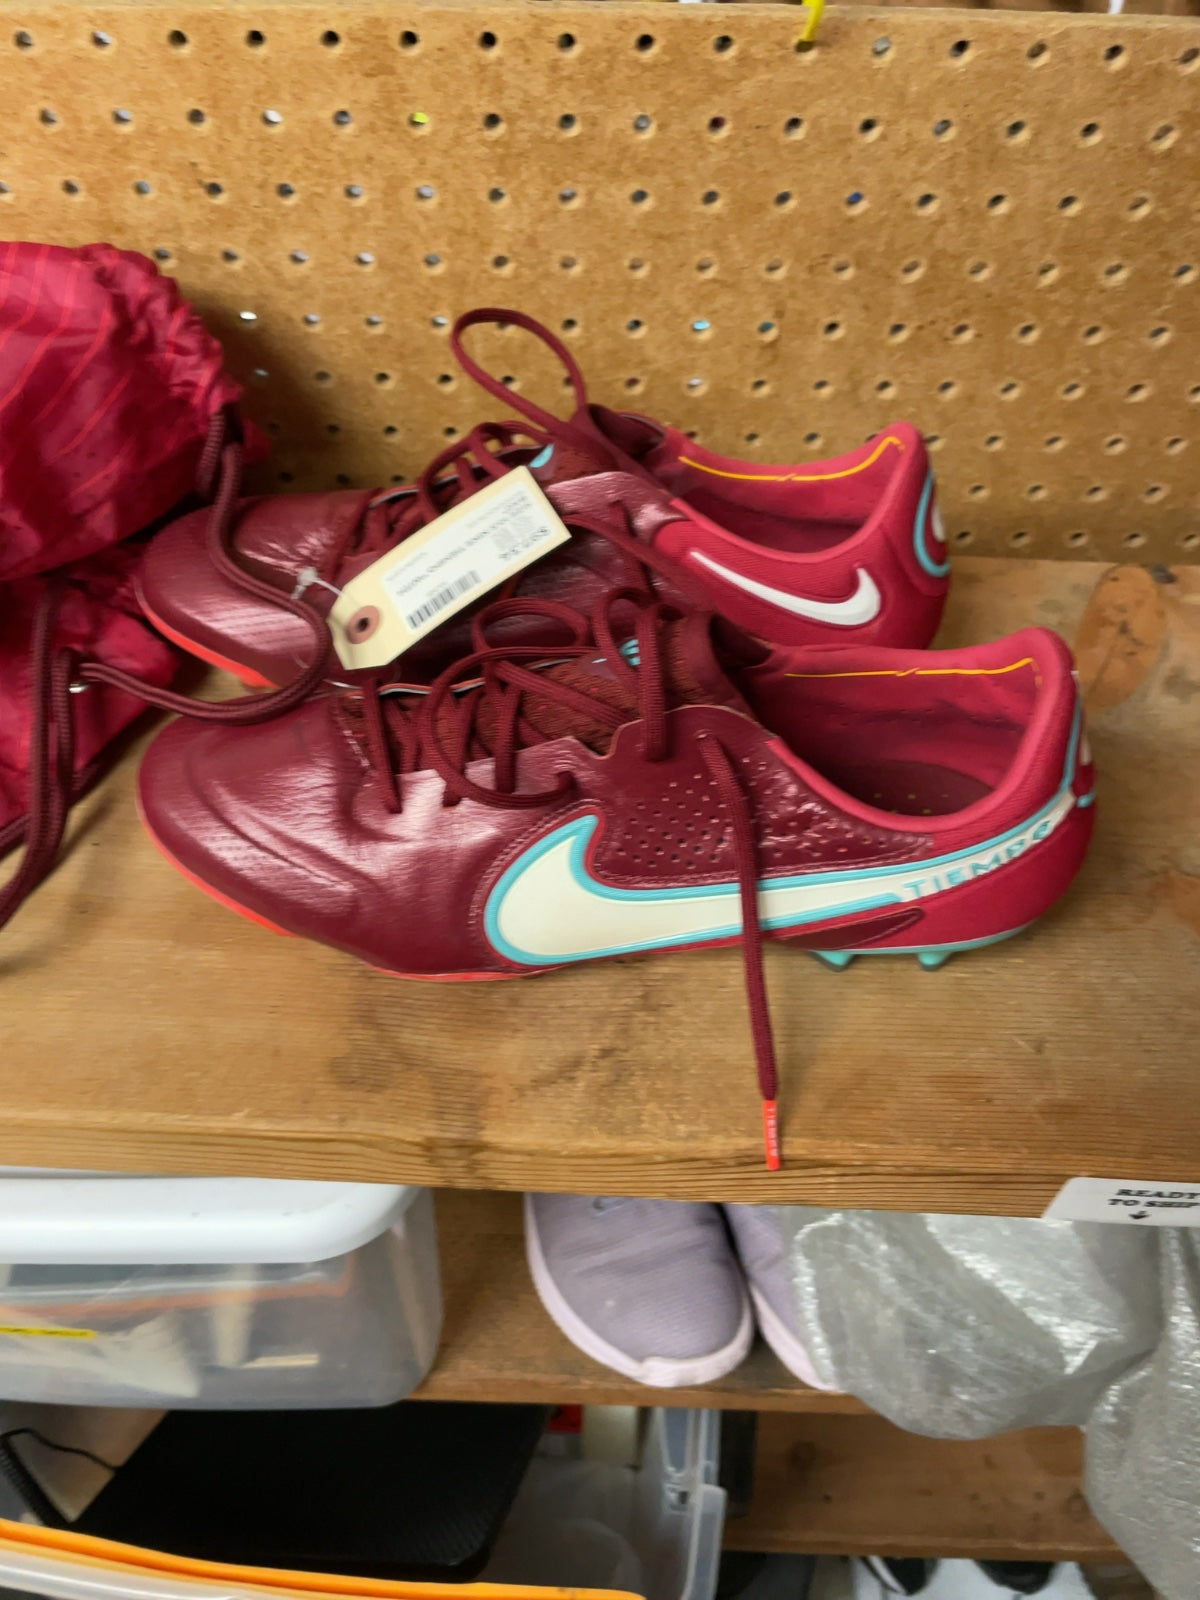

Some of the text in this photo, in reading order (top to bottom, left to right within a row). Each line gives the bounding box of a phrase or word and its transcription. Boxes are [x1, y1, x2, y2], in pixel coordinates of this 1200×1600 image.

[904, 820, 1051, 898] TIEMPO
[1116, 1188, 1200, 1199] READY
[1107, 1197, 1200, 1208] TO SHIP
